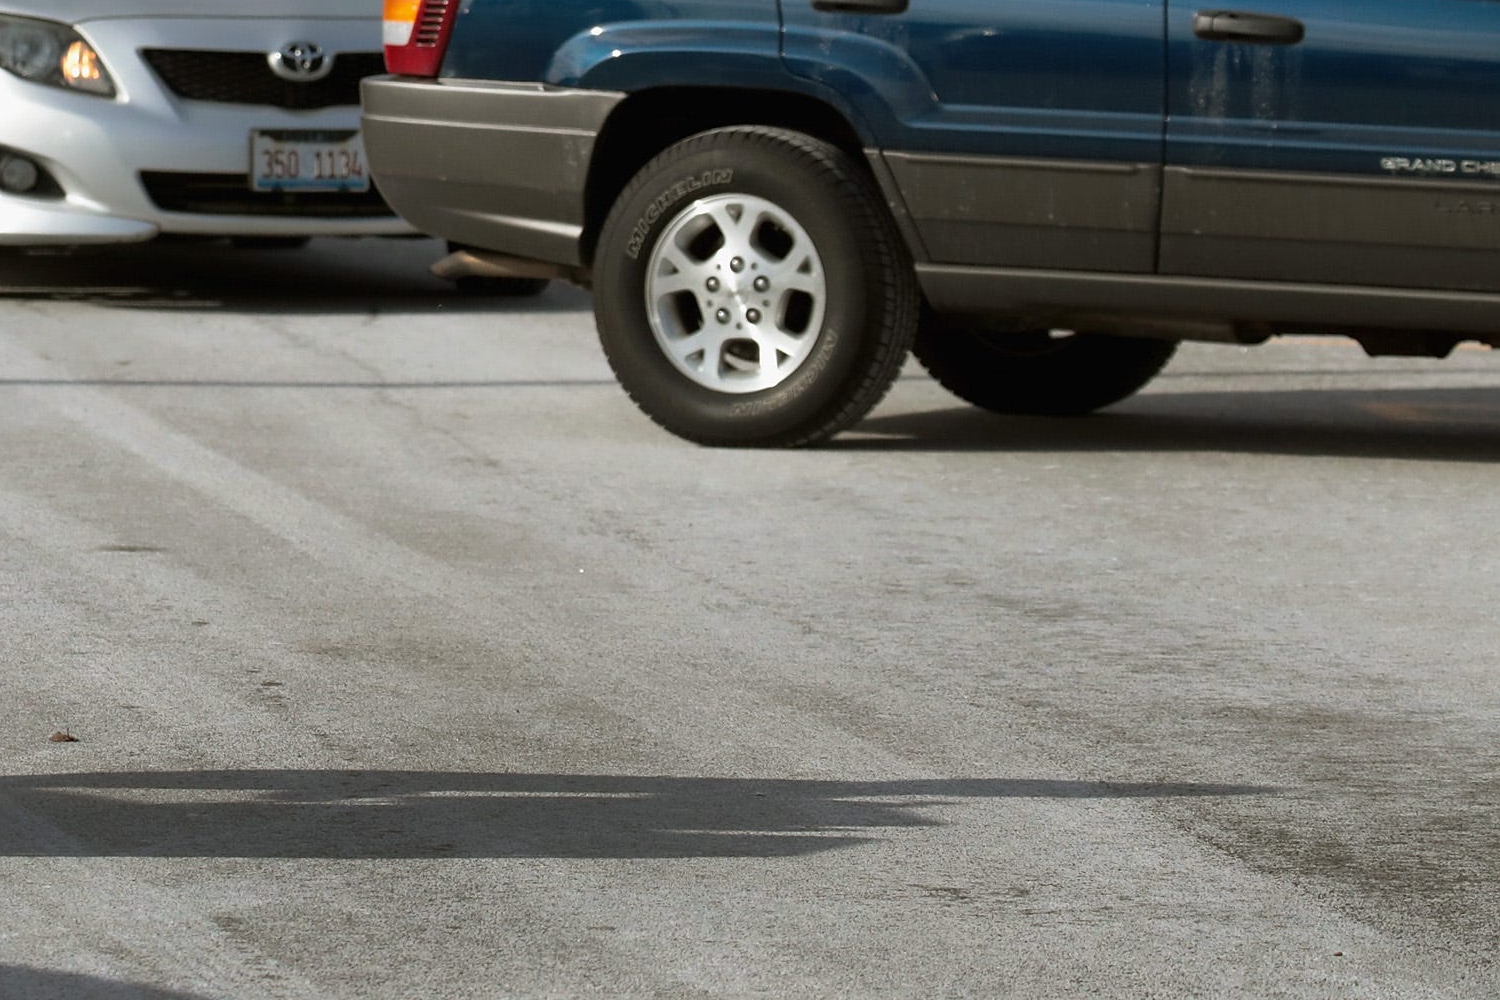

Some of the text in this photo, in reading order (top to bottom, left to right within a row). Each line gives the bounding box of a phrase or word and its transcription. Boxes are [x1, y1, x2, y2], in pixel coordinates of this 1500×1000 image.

[261, 150, 362, 180] 350 1134
[1381, 157, 1456, 172] GRAND
[626, 168, 734, 259] MICHELIN
